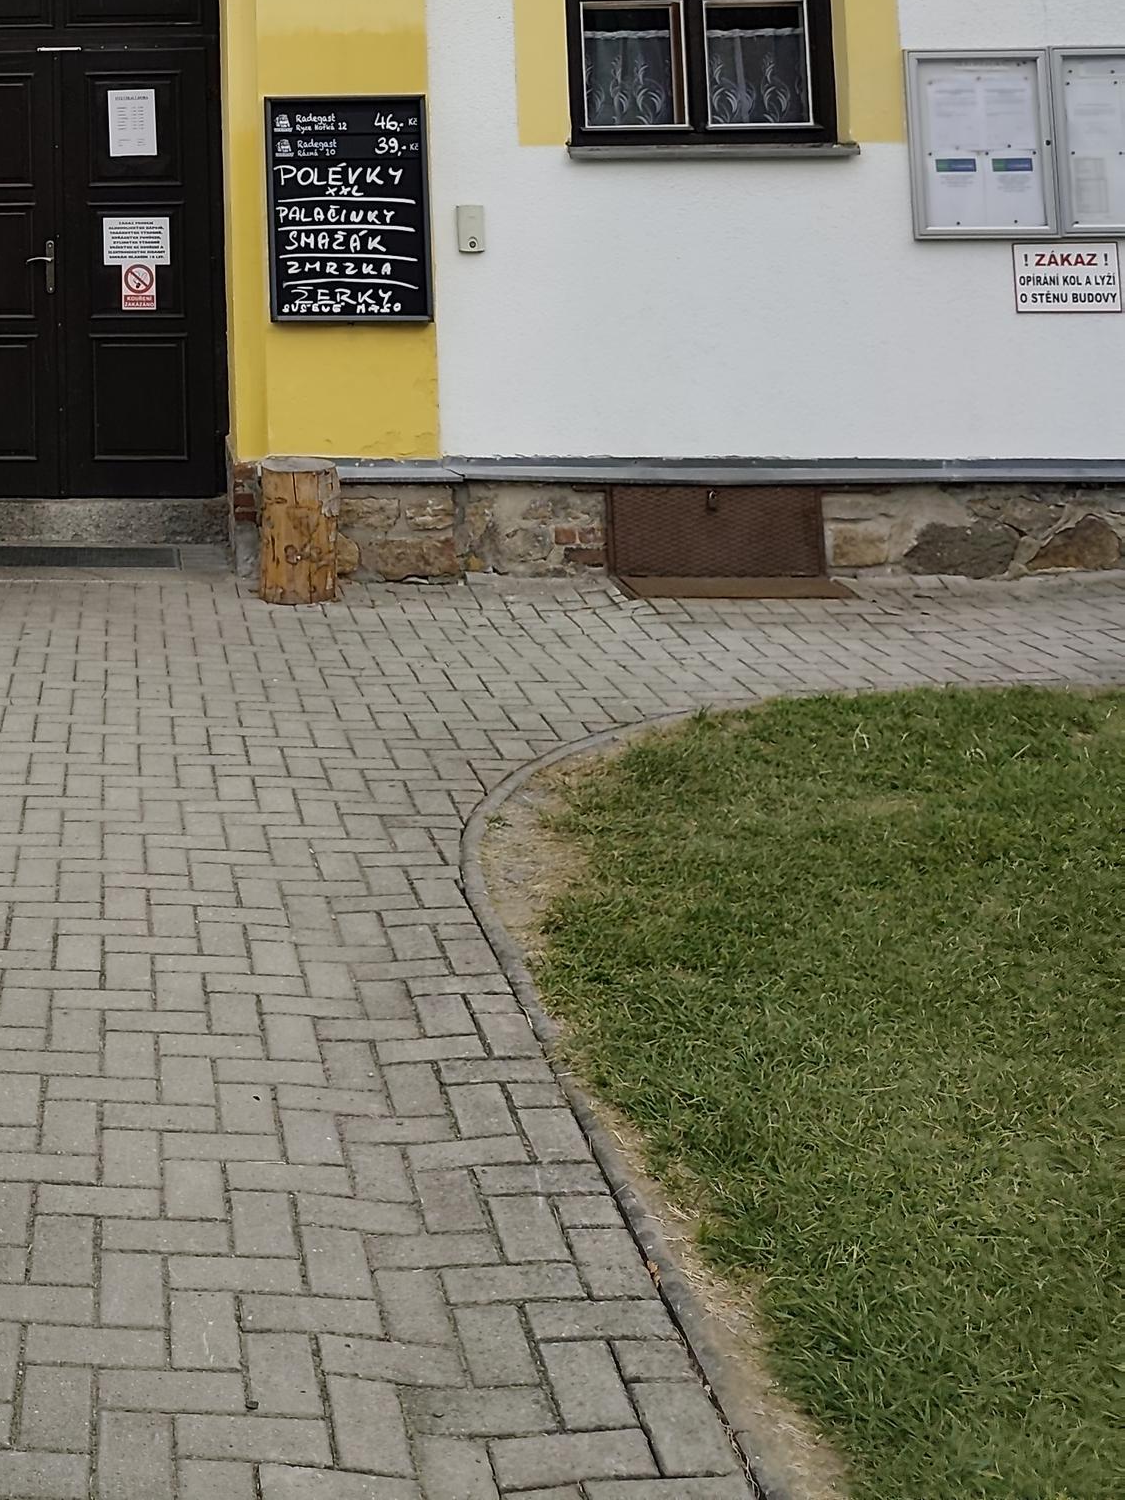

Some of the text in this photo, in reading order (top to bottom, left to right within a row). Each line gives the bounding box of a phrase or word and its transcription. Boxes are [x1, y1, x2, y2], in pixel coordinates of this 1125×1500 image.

[295, 113, 336, 125] Radegast
[408, 117, 418, 126] Kč
[337, 122, 348, 131] 12
[297, 139, 338, 151] Radegast
[409, 143, 419, 151] Kč
[273, 162, 403, 186] POLÉVKY
[276, 205, 395, 224] PALAČINKY
[285, 230, 387, 253] SMAŽÁK
[1034, 250, 1098, 266] ZÁKAZ
[1019, 273, 1116, 286] OPÍRÁNÍ KOL A LYŽÍ
[1020, 290, 1117, 303] O STĚNU BUDOVY
